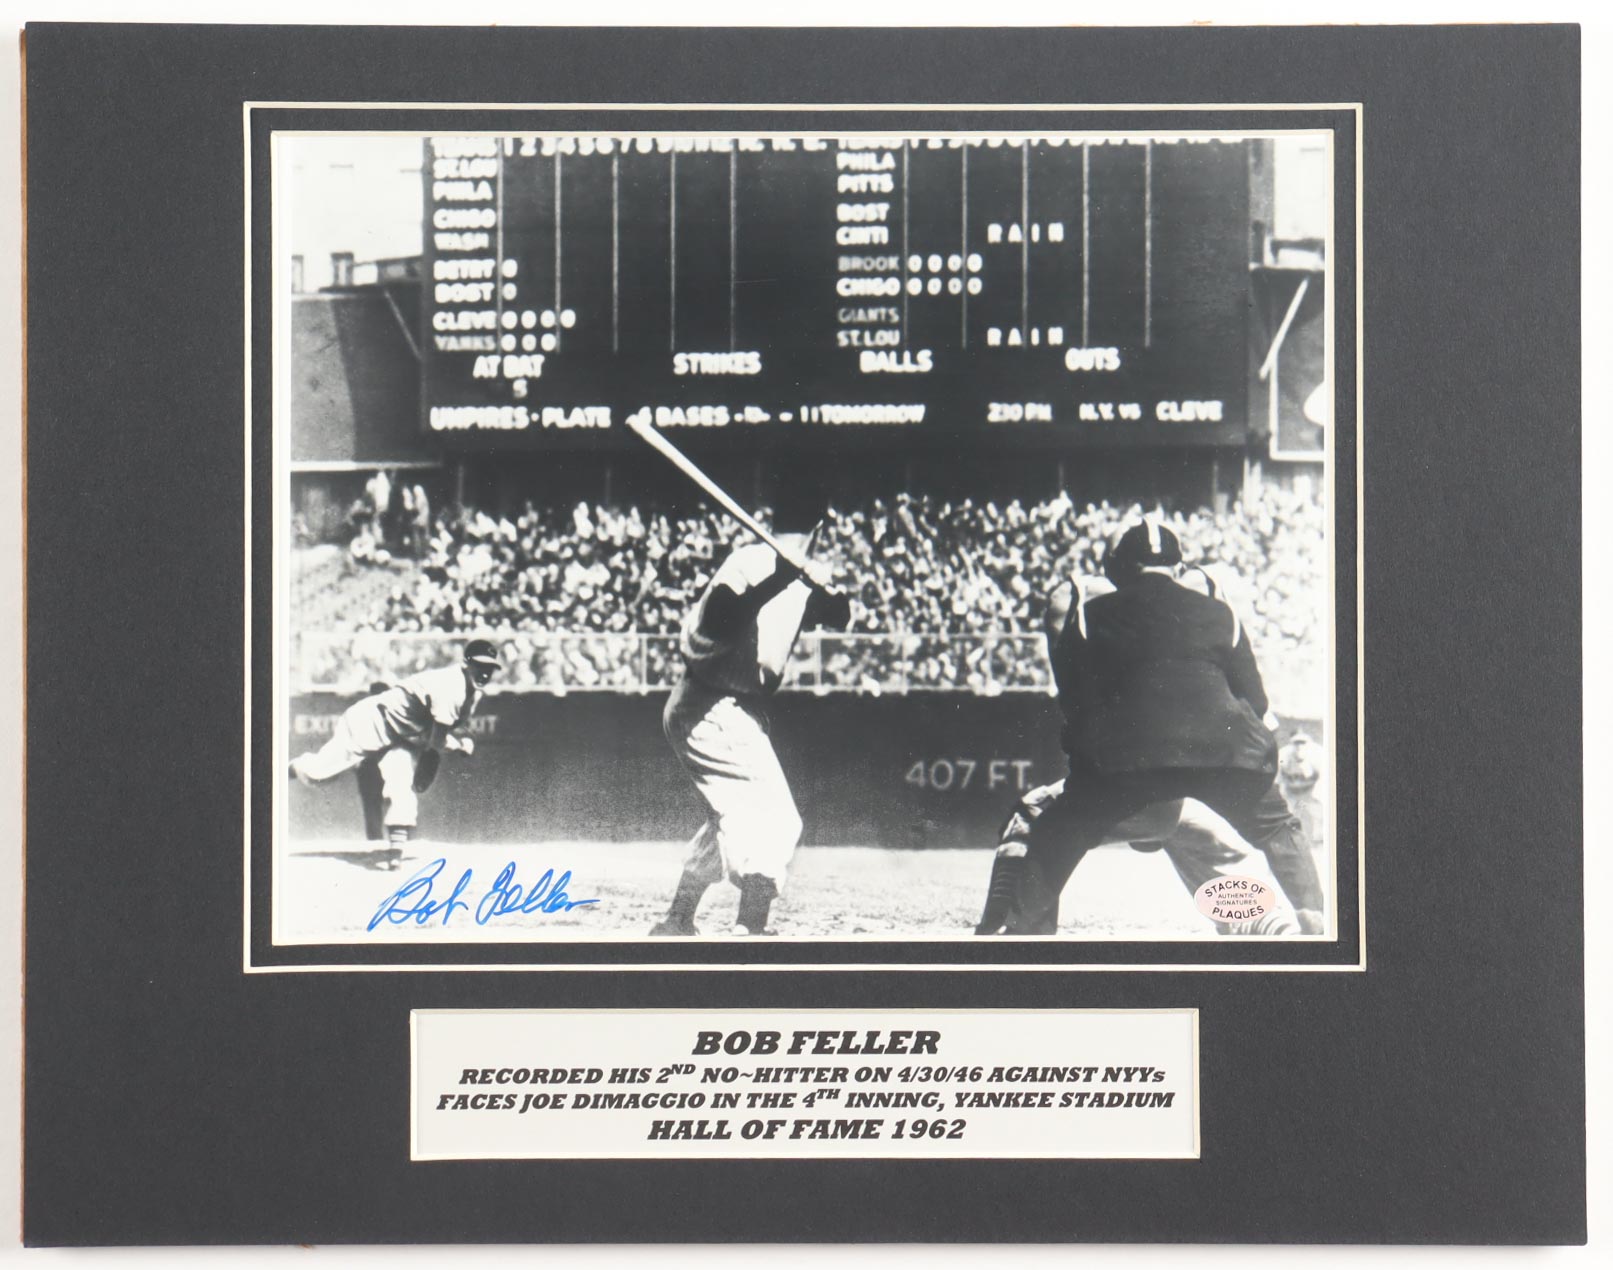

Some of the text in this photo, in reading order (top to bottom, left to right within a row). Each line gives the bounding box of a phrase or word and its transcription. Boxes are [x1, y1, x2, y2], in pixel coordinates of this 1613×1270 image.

[837, 256, 900, 272] BROOK
[837, 306, 899, 323] GIANTS
[473, 355, 501, 378] AT
[674, 352, 761, 374] STRIKES
[860, 350, 932, 372] BALLS
[905, 761, 976, 790] 407
[1205, 880, 1266, 897] STACKS OF
[1212, 905, 1265, 919] PLAQUES
[692, 1031, 940, 1055] BOB FELLER
[459, 1069, 603, 1084] RECORDED
[608, 1068, 652, 1083] HIS
[855, 1067, 892, 1082] ON
[898, 1067, 983, 1082] 4/30/46
[987, 1067, 1098, 1082] AGAINST
[1102, 1067, 1165, 1082] NYYs
[437, 1094, 516, 1109] FACES
[519, 1094, 567, 1113] JOE
[572, 1093, 705, 1109] DIMAGGIO
[711, 1093, 741, 1108] IN
[747, 1093, 796, 1108] THE
[845, 1092, 944, 1112] INNING,
[955, 1093, 1054, 1107] YANKEE
[1059, 1092, 1175, 1107] STADIUM
[648, 1119, 966, 1139] HALL OF FAME 1962
